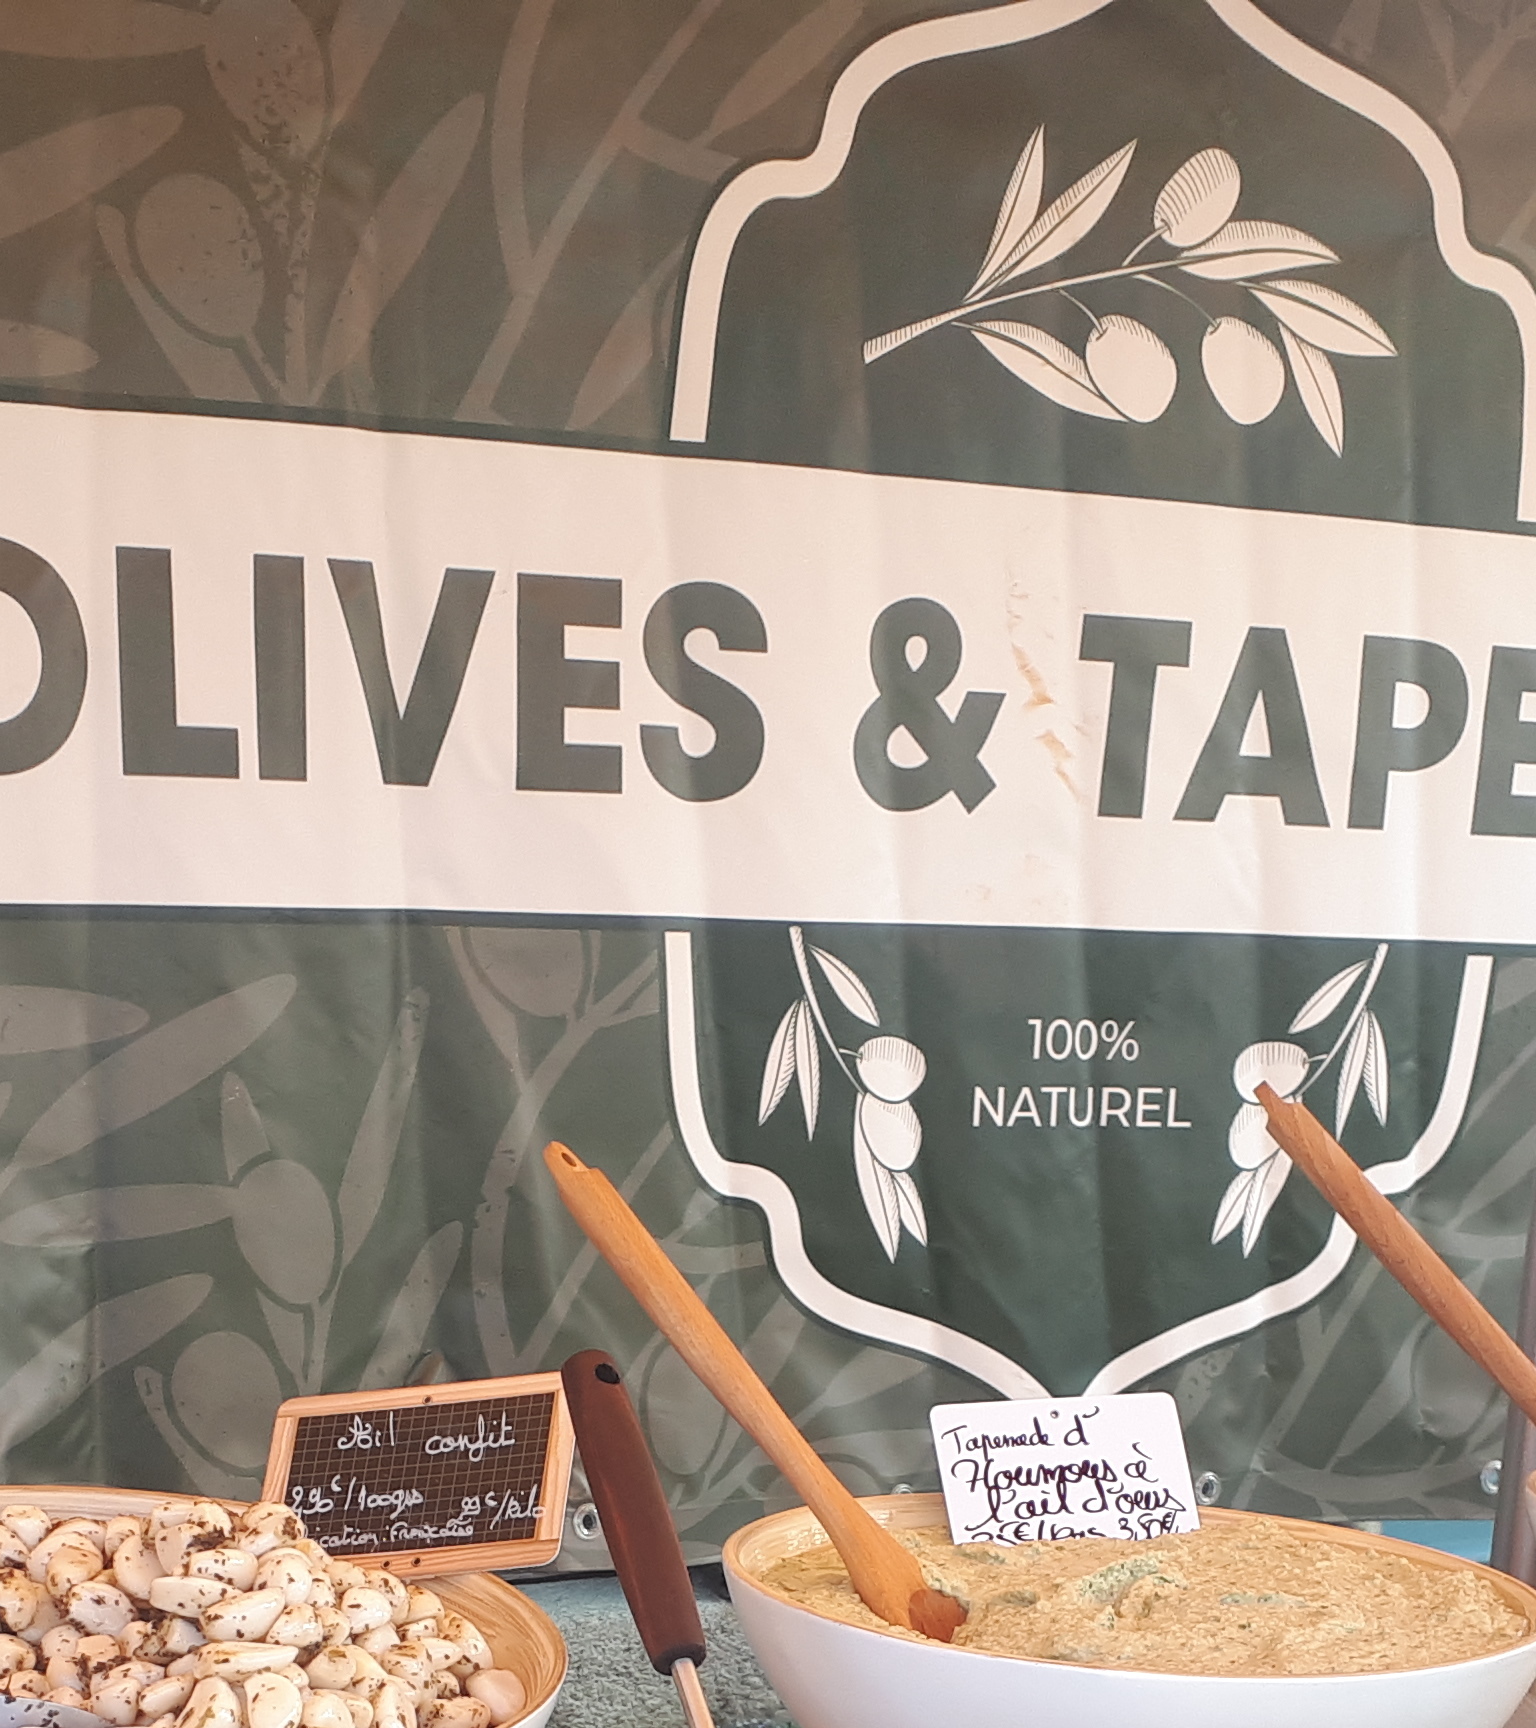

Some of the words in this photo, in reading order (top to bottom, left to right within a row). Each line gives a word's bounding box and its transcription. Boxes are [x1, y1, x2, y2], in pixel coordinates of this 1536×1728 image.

[853, 596, 1007, 815] &
[1027, 1018, 1140, 1062] 100%
[972, 1085, 1192, 1128] NATUREL
[424, 1409, 516, 1463] confit
